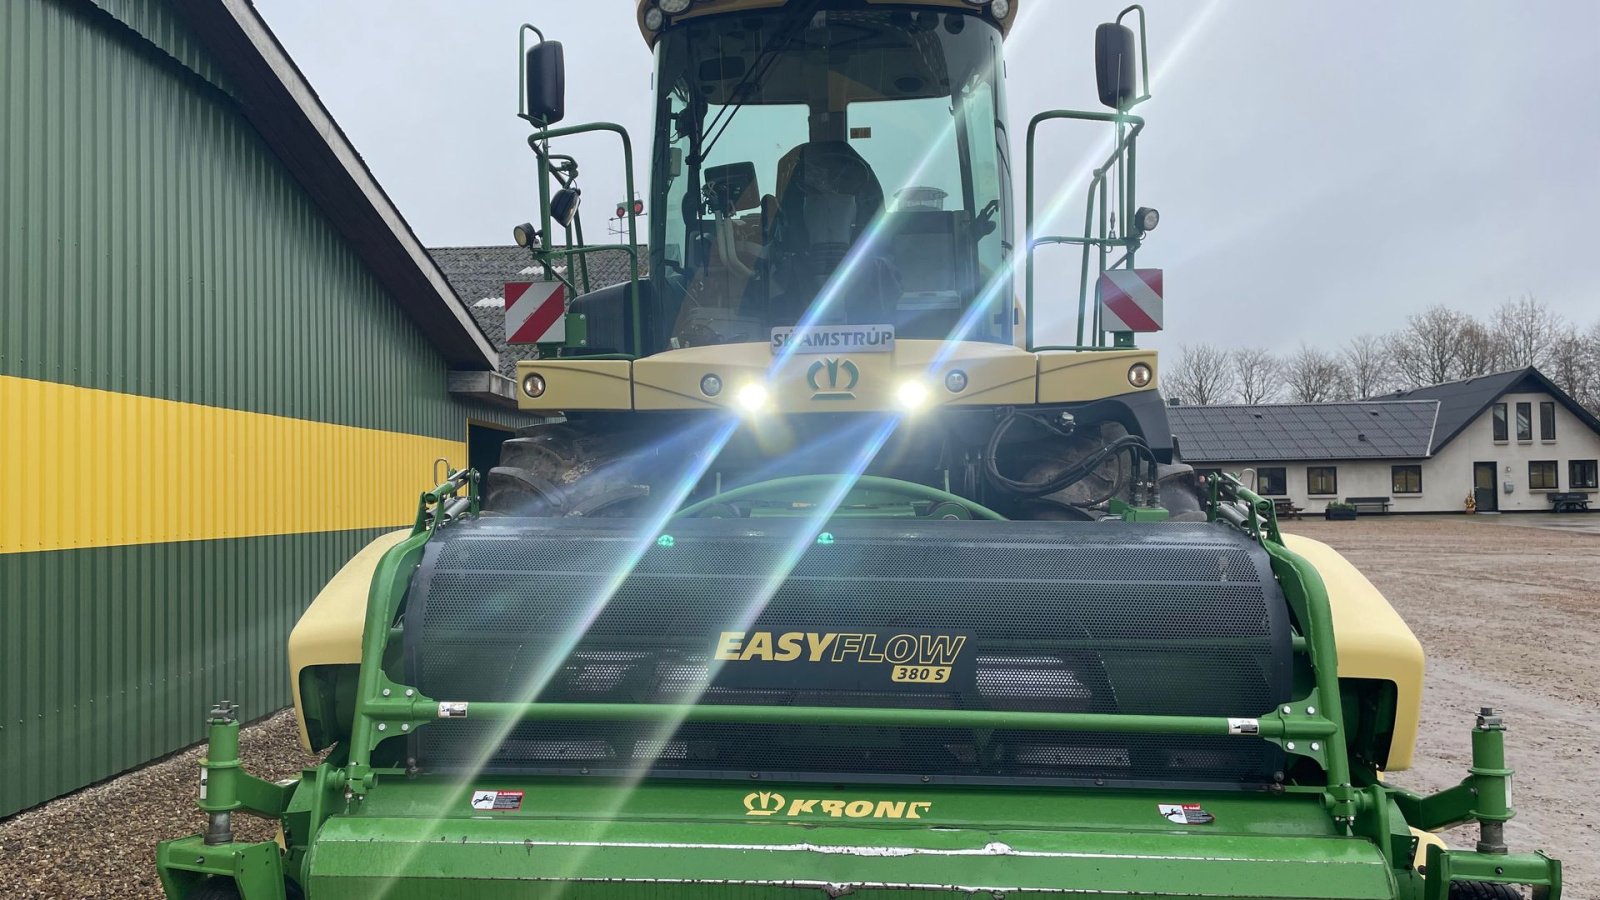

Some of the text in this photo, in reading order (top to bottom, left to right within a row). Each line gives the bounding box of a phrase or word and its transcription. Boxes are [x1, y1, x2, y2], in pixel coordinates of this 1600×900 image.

[714, 631, 967, 665] EASYFLOW
[897, 668, 945, 680] 380 S
